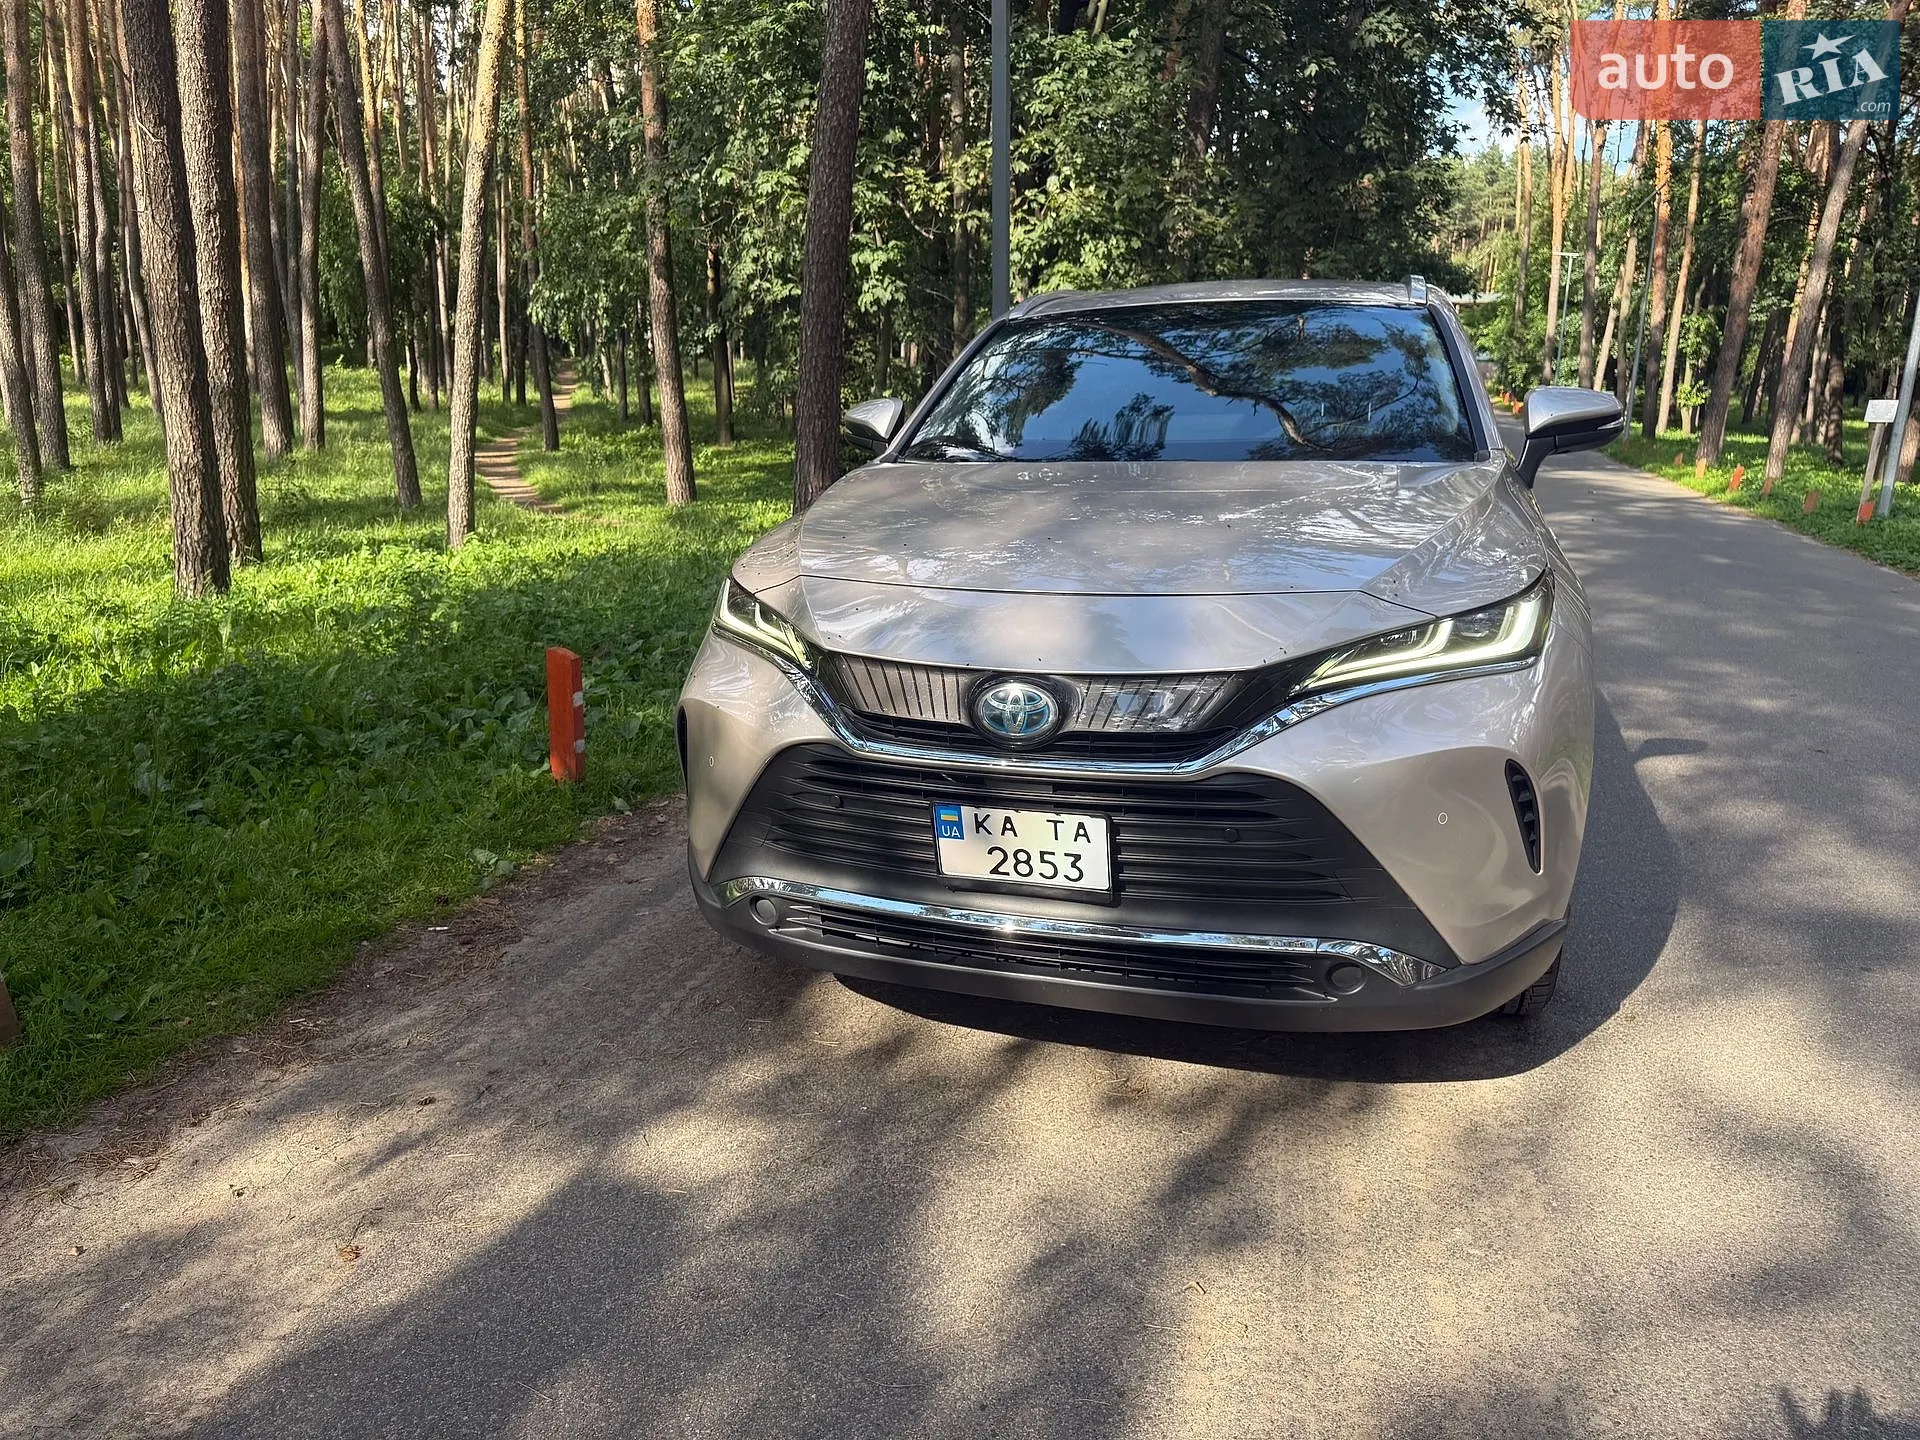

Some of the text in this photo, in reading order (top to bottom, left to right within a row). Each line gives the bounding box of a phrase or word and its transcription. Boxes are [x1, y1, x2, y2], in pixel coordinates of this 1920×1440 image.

[942, 825, 961, 838] UA
[974, 812, 1091, 843] KA TA
[987, 846, 1084, 883] 2853
